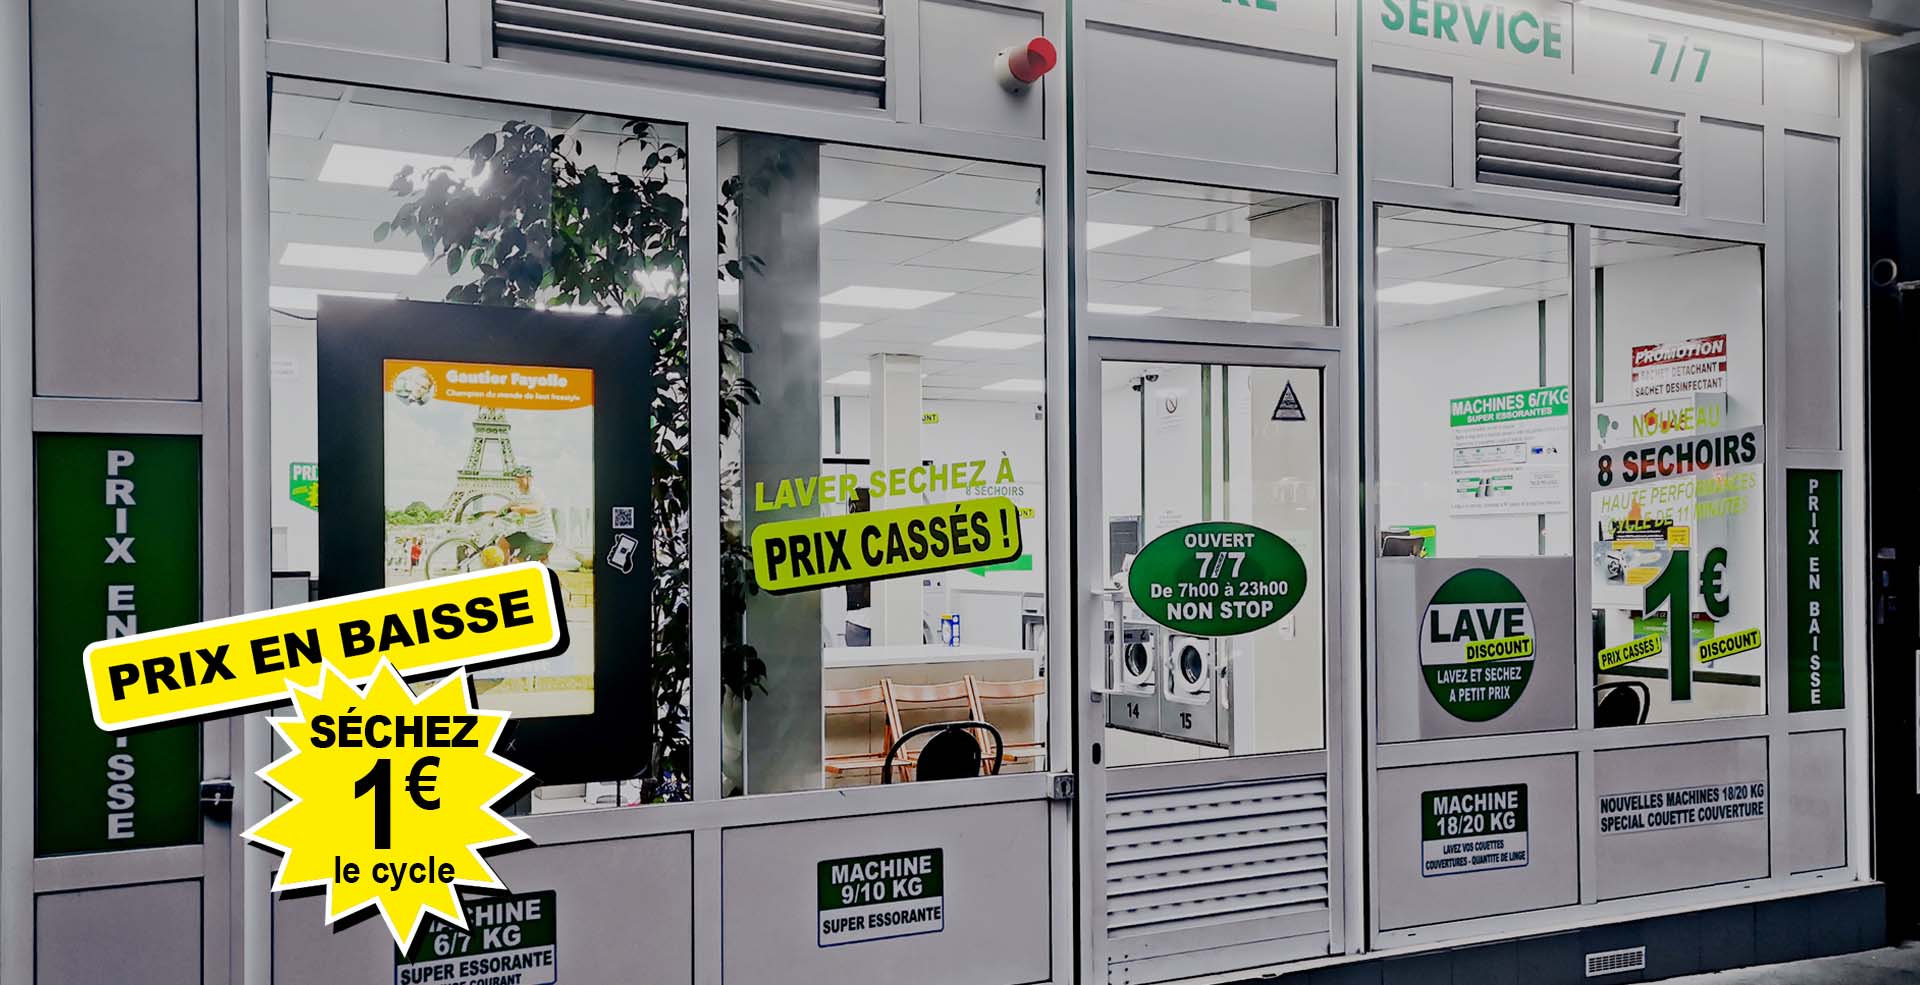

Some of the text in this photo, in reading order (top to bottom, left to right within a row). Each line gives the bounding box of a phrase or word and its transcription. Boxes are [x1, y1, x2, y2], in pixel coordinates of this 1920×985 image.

[1381, 0, 1561, 59] SERVICE
[1647, 36, 1712, 82] 7/7
[1635, 340, 1724, 365] PROMOTION
[1672, 362, 1717, 377] DETACHANT
[1635, 377, 1723, 397] SACHET DESINFECTANT
[1452, 387, 1568, 416] MACHINES 6/7KG
[1467, 407, 1552, 423] SUPER ESSORANTES
[1633, 404, 1720, 438] NOUVEAU
[1598, 455, 1613, 487] 8
[1623, 432, 1757, 483] SECHOIRS
[755, 451, 1015, 512] LAVER SECHEZ À
[974, 486, 1025, 496] SECHOIRS
[1601, 472, 1757, 513] HAUTE PERFORMANCES
[104, 450, 136, 564] PRIX
[1608, 511, 1652, 535] CYCLE
[1655, 507, 1674, 527] DE
[1690, 496, 1749, 520] MINUTES
[765, 504, 1010, 581] PRIX CASSÉS !
[1184, 533, 1255, 548] OUVERT
[1195, 552, 1246, 579] 7/7
[1151, 581, 1288, 599] De 7h00 à 23h00
[1808, 479, 1821, 705] PRIX EN BAISSE
[107, 585, 137, 640] EN
[1167, 600, 1273, 620] NON STOP
[1645, 547, 1730, 701] 1€
[1430, 608, 1525, 643] LAVE
[1467, 640, 1530, 660] DISCOUNT
[1601, 648, 1622, 667] PRIX
[1623, 639, 1655, 660] CASSES
[1700, 631, 1758, 659] DISCOUNT
[1437, 666, 1522, 684] LAVEZ ET SECHEZ
[1449, 685, 1510, 703] A PETIT PRIX
[1127, 703, 1139, 719] 14
[1180, 712, 1192, 729] 15
[1433, 790, 1518, 816] MACHINE
[1600, 783, 1764, 814] NOUVELLES MACHINES 18/20 KG
[1437, 811, 1516, 836] 18/20 KG
[1600, 801, 1764, 833] SPECIAL COUETTE COUVERTURE
[1426, 857, 1468, 871] COUVERTURES
[1472, 853, 1499, 865] QUANTITE
[1500, 852, 1508, 862] DE
[1509, 850, 1526, 861] LINGE
[1443, 840, 1504, 855] LAVEZ VOS COUETTES
[831, 855, 932, 885] MACHINE
[841, 877, 923, 904] 9/10 KG
[823, 906, 941, 934] SUPER ESSORANTE
[434, 924, 522, 956] 6/7 KG
[401, 950, 553, 985] SUPER ESSORANTE
